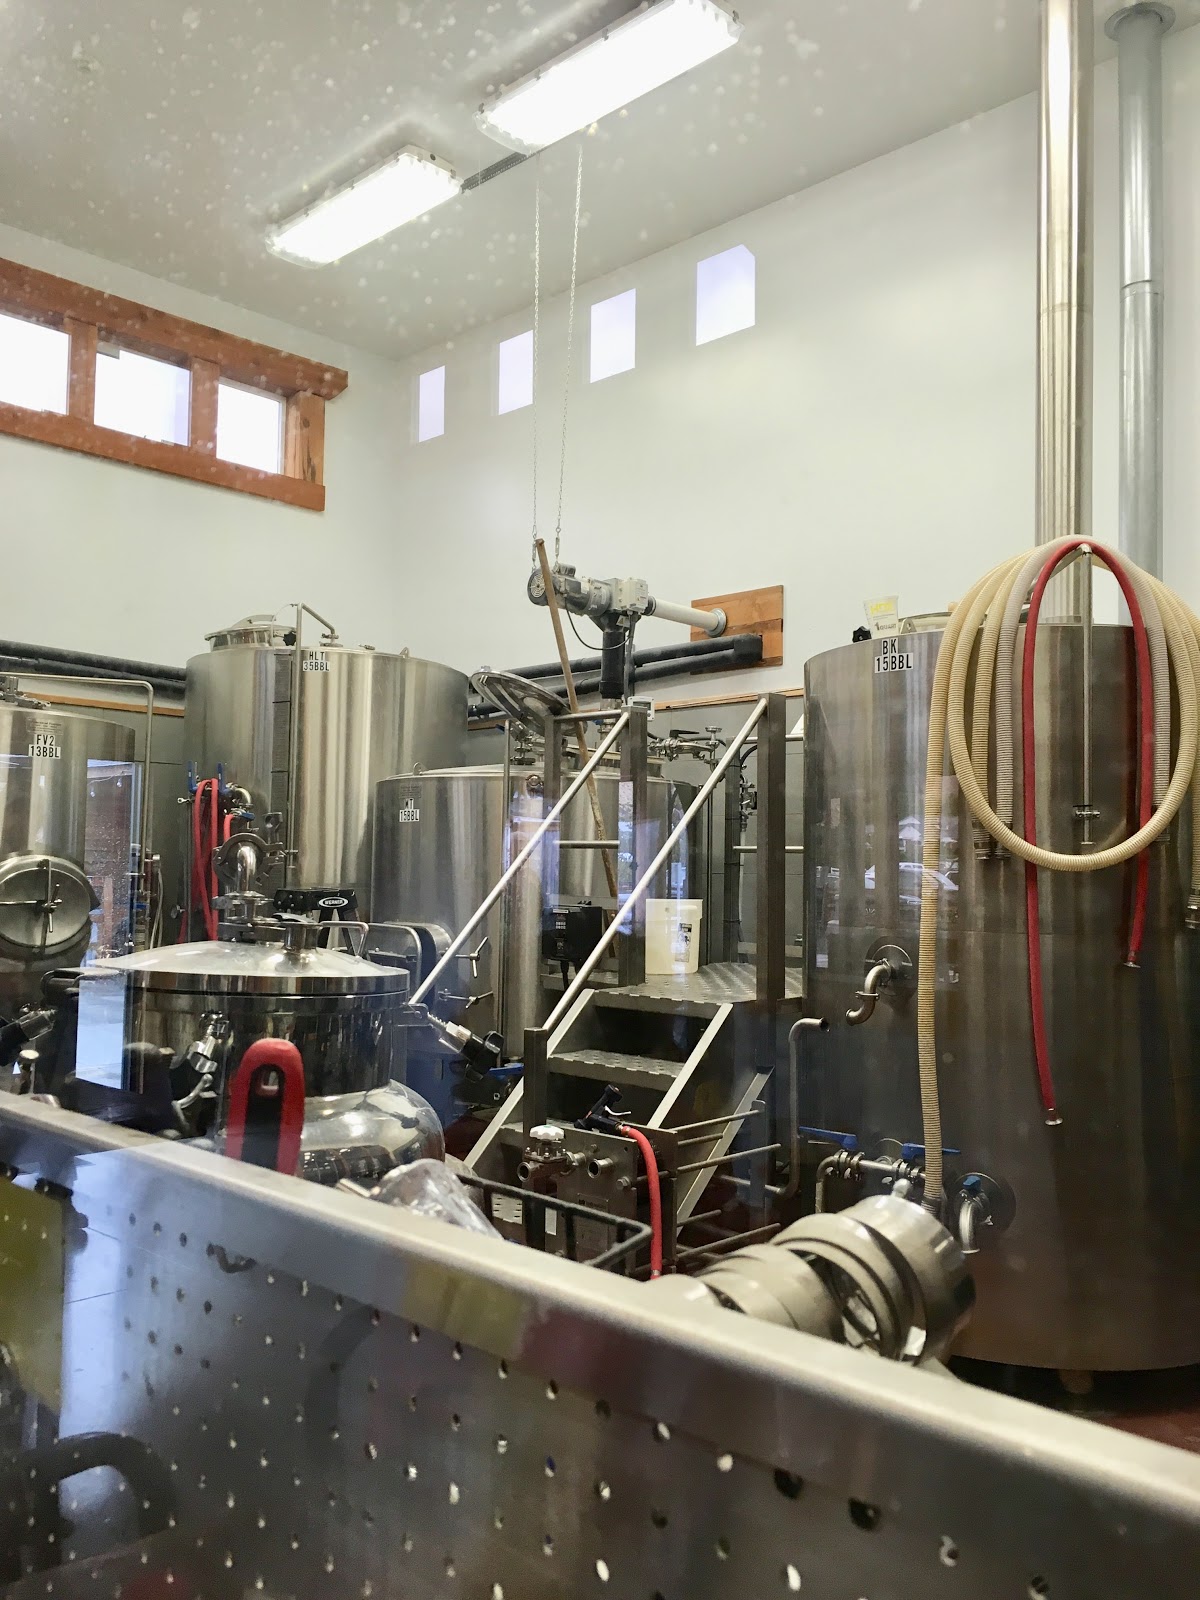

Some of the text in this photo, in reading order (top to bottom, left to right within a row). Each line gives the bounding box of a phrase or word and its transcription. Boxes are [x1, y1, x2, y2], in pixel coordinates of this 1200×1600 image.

[882, 638, 897, 654] BK
[309, 651, 325, 661] HLT
[303, 661, 330, 671] 35BBL
[876, 653, 912, 672] 15BBL
[36, 734, 55, 746] FV2
[30, 745, 60, 758] 13BBL
[400, 810, 419, 821] 15BBL
